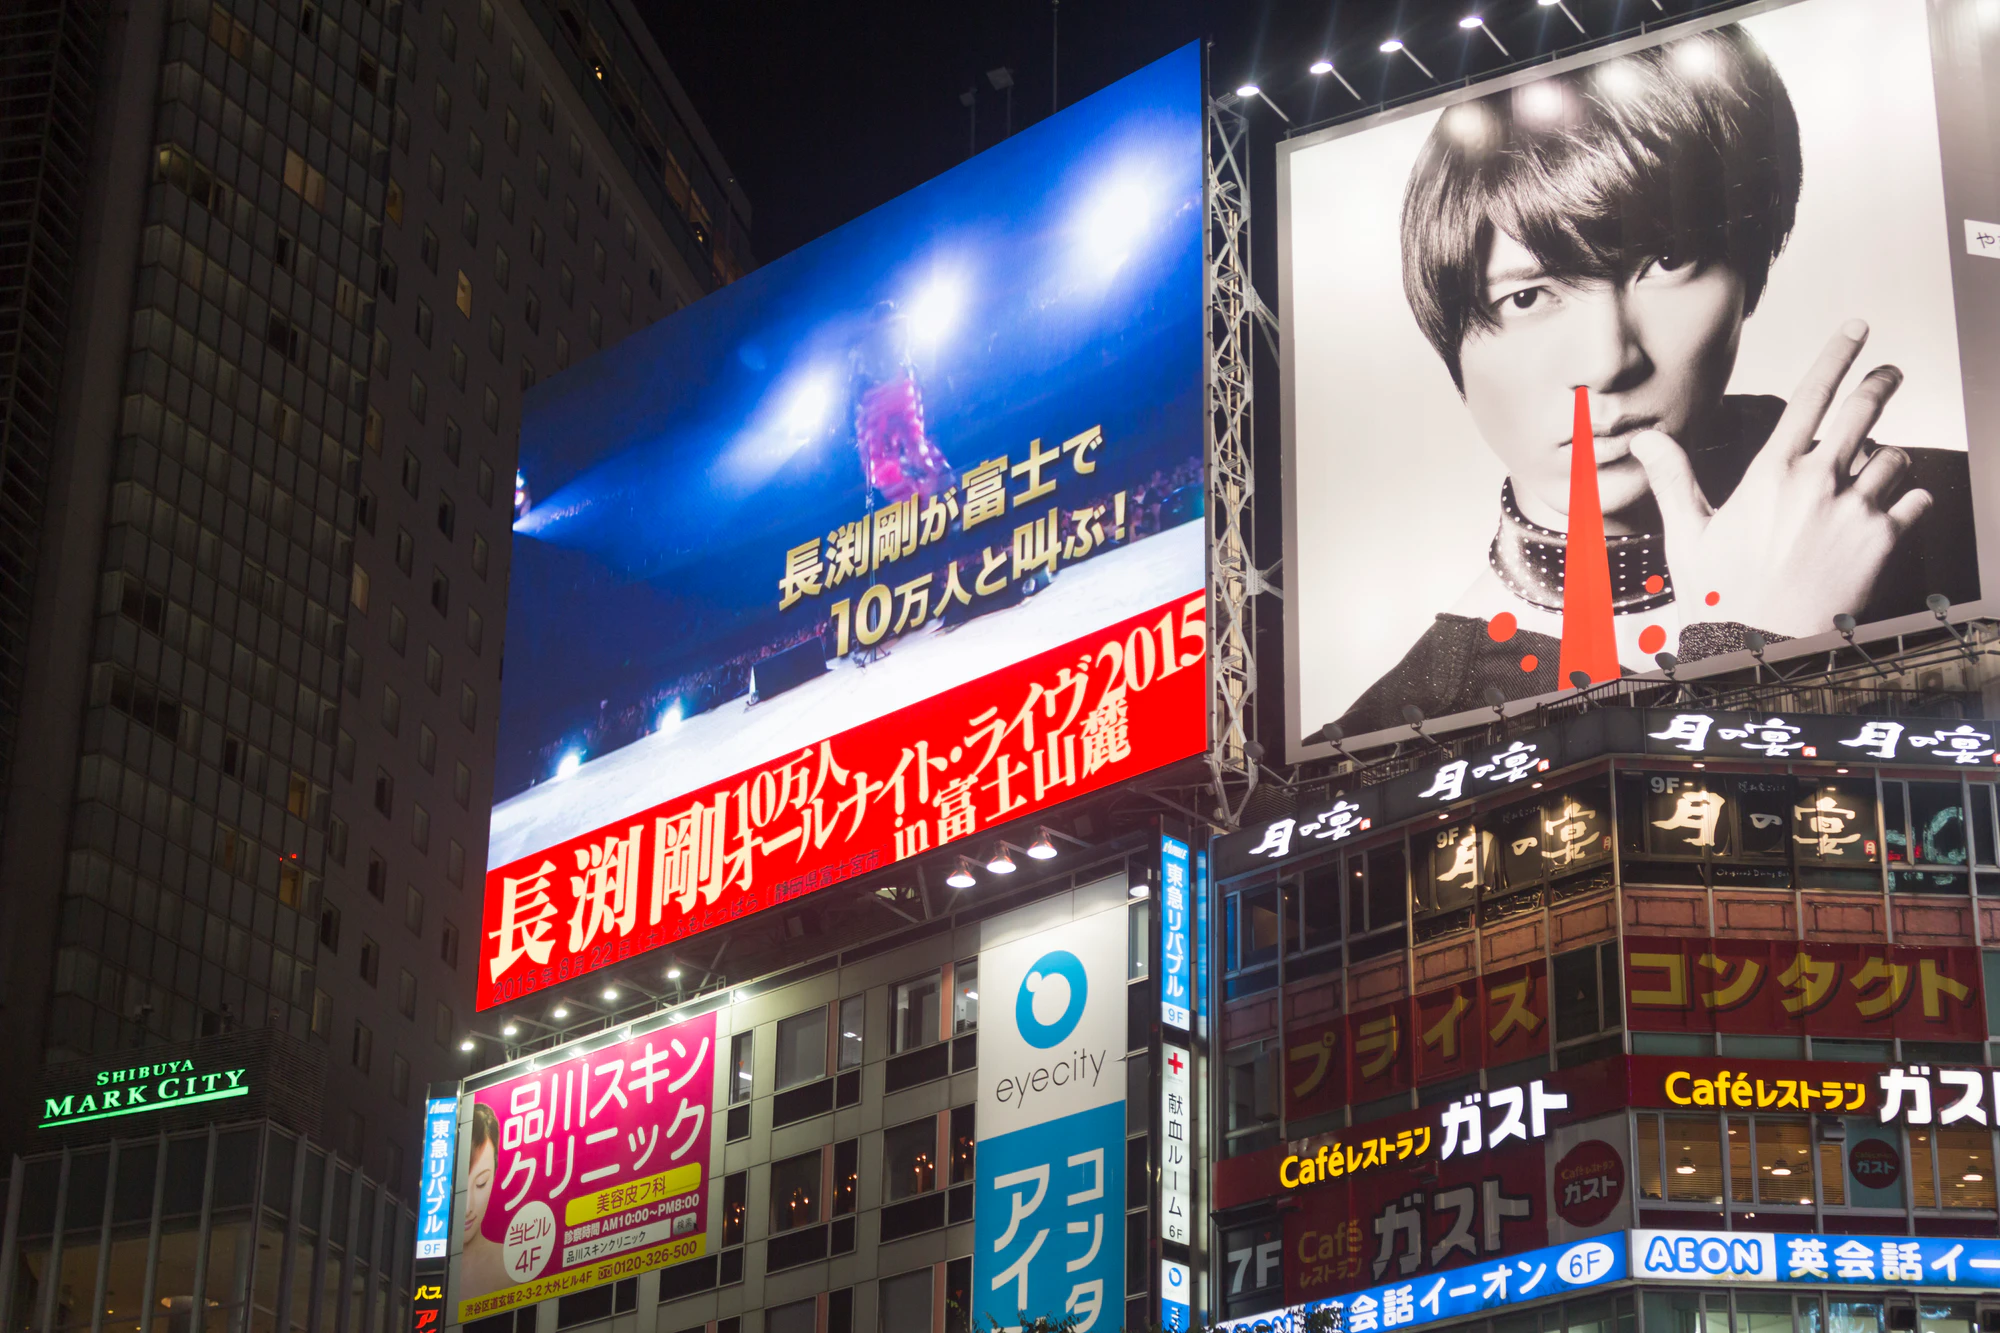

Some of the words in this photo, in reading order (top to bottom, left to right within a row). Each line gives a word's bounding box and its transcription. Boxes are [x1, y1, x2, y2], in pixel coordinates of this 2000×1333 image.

[1976, 231, 2000, 250] や
[778, 424, 1103, 612] 長渕剛が富士で
[830, 491, 1127, 658] 10万人と叫ぶ！
[1648, 714, 1805, 757] 月の宴
[1838, 721, 1995, 763] 月の宴
[732, 739, 851, 841] 10万人
[1418, 741, 1540, 800] 月の宴
[1650, 777, 1680, 794] 9F
[1249, 800, 1362, 858] 月の宴
[1436, 827, 1459, 849] 9F
[1651, 792, 1861, 856] 月の宴
[488, 790, 733, 984] 長渕剛
[1166, 862, 1184, 999] 東急リバブル
[1630, 952, 1969, 1018] コンタクト
[1168, 1008, 1184, 1023] 9F
[1289, 975, 1541, 1097] プライス
[43, 1085, 148, 1119] MARK
[157, 1069, 246, 1100] CITY
[96, 1059, 194, 1086] SHIBUYA
[502, 1036, 709, 1150] 品川スキン
[996, 1047, 1107, 1109] eyecity
[1880, 1065, 2000, 1127] ガス
[1441, 1079, 1568, 1161] ガスト
[424, 1119, 450, 1234] 東急リバブル
[501, 1098, 705, 1211] クリニック
[1168, 1092, 1184, 1218] 献血ルーム
[1857, 1160, 1896, 1175] ガスト
[596, 1176, 666, 1214] 美容皮フ科
[1565, 1175, 1617, 1207] ガスト
[509, 1219, 551, 1247] 当ビル
[566, 1231, 646, 1262] 品川スキンクリニック
[677, 1217, 694, 1231] 検索
[1169, 1225, 1183, 1239] 6F
[1298, 1220, 1363, 1263] Café
[1372, 1180, 1530, 1281] ガスト
[424, 1244, 441, 1256] 9F
[515, 1246, 541, 1274] 4F
[614, 1241, 697, 1276] 0120-326-500
[991, 1163, 1050, 1333] アイ
[1227, 1240, 1282, 1294] 7F
[1569, 1253, 1601, 1280] 6F
[1646, 1236, 1763, 1275] AEON
[1300, 1257, 1362, 1289] レストラン
